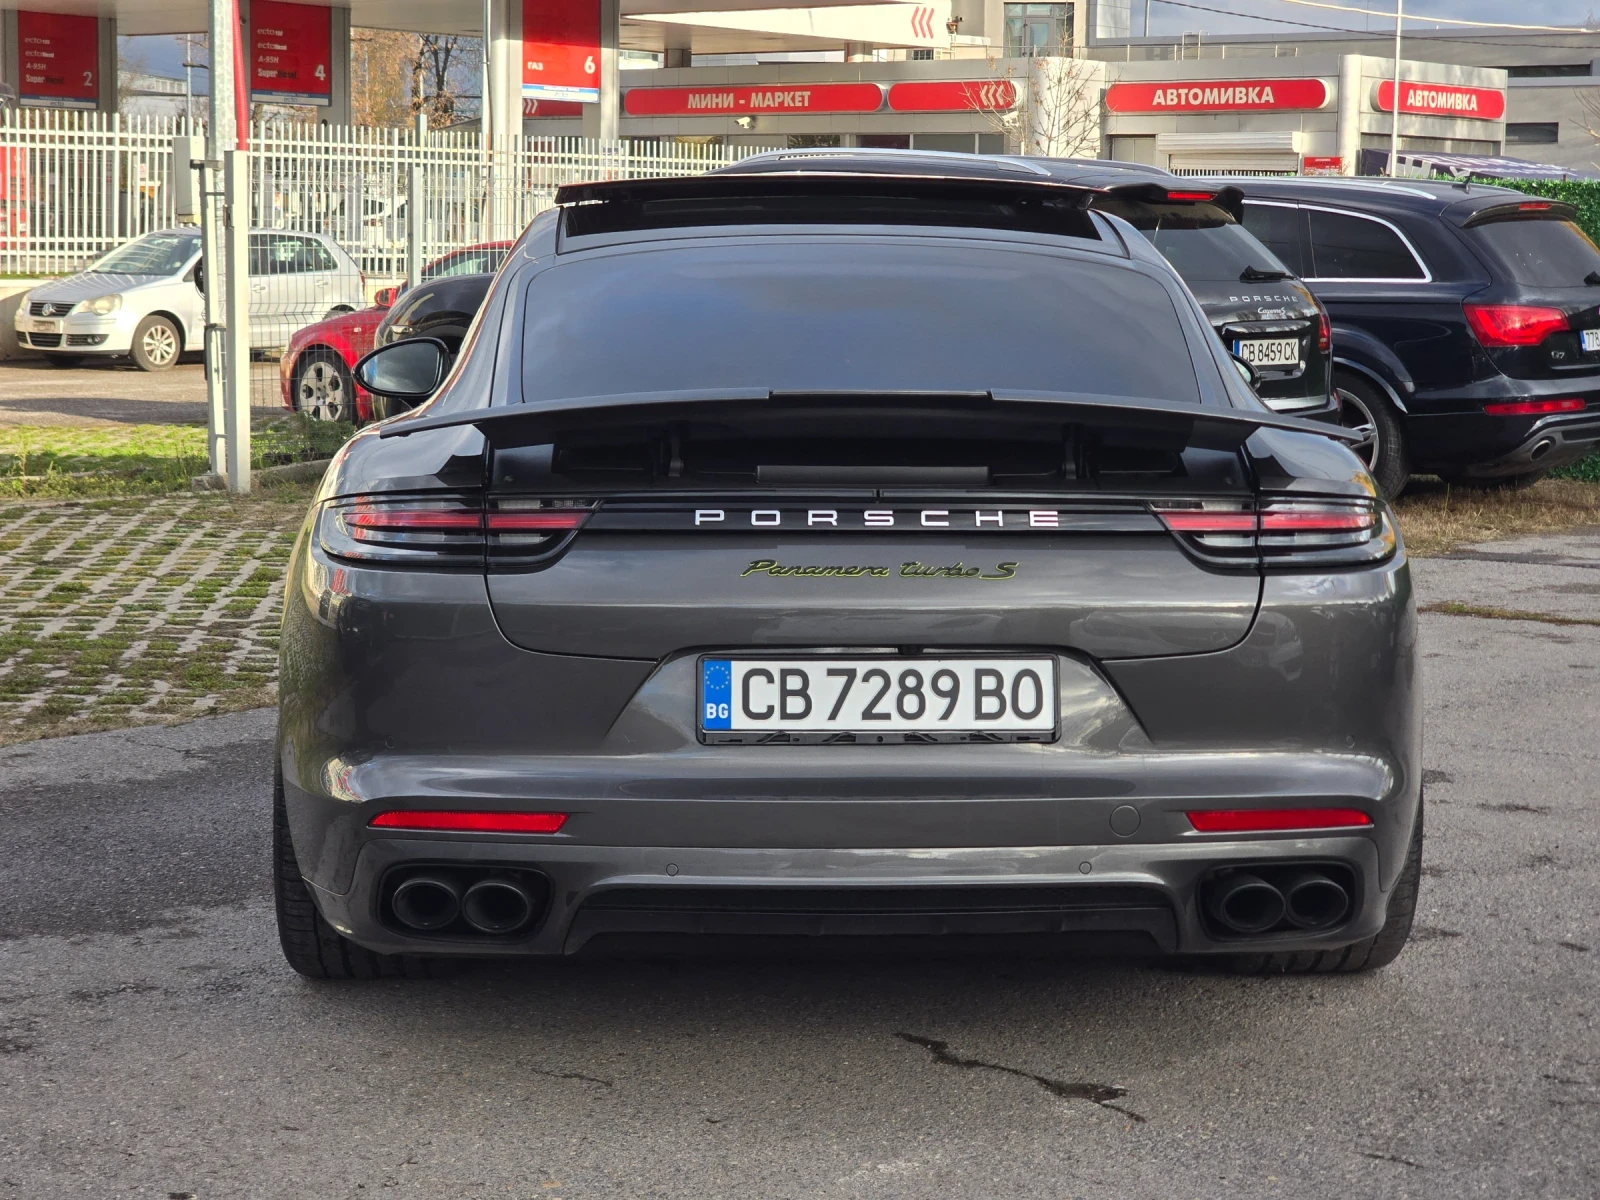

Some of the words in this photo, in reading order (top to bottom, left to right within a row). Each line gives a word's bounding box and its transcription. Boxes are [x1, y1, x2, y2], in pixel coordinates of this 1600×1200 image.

[314, 64, 326, 81] 4
[527, 61, 544, 71] ГАЗ
[584, 55, 596, 74] 6
[82, 71, 93, 86] 2
[687, 93, 734, 109] МИНИ
[750, 91, 811, 108] МАРКЕТ
[1152, 86, 1275, 106] АВТОМИВКА
[1406, 89, 1478, 111] АВТОМИВКА
[1229, 295, 1299, 303] PORSCHE
[1242, 343, 1255, 362] CB
[1257, 342, 1283, 362] 8459
[1284, 341, 1297, 361] CK
[694, 509, 1059, 527] PORSCHE
[740, 559, 889, 577] Panamera
[899, 561, 981, 578] turbo
[978, 562, 1019, 580] S
[742, 668, 813, 720] CB
[826, 668, 960, 720] 7289
[706, 703, 729, 719] BG
